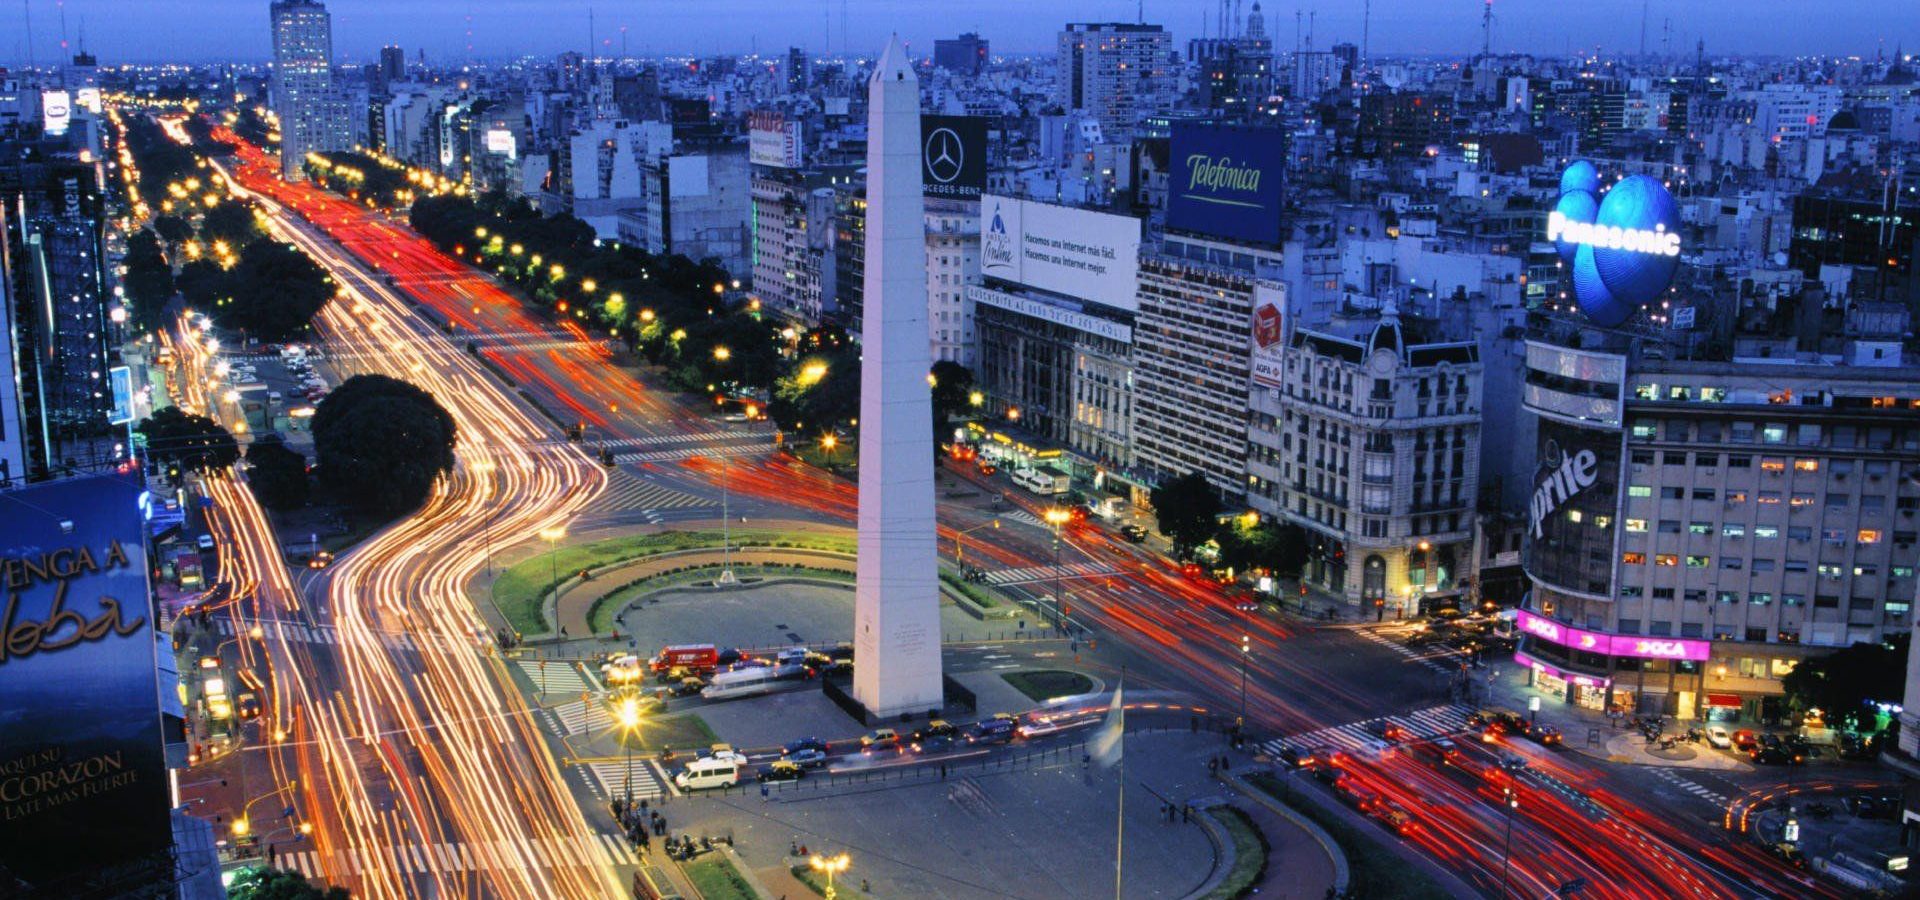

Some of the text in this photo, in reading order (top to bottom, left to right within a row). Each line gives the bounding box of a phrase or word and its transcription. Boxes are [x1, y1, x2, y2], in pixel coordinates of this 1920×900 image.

[923, 184, 981, 195] RCEDES-BENZ
[1025, 231, 1050, 246] Hacemos
[1051, 240, 1062, 249] una
[1088, 245, 1100, 256] más
[1548, 211, 1681, 257] Panasonic
[1025, 247, 1050, 262] Hacemos
[1051, 255, 1062, 265] una
[1088, 263, 1106, 276] mejor.
[1256, 363, 1271, 375] AGFA
[0, 538, 129, 588] ENGA A
[1650, 641, 1686, 657] OCA
[0, 750, 122, 802] CORAZON
[5, 769, 137, 820] LATE MAS FUERTE
